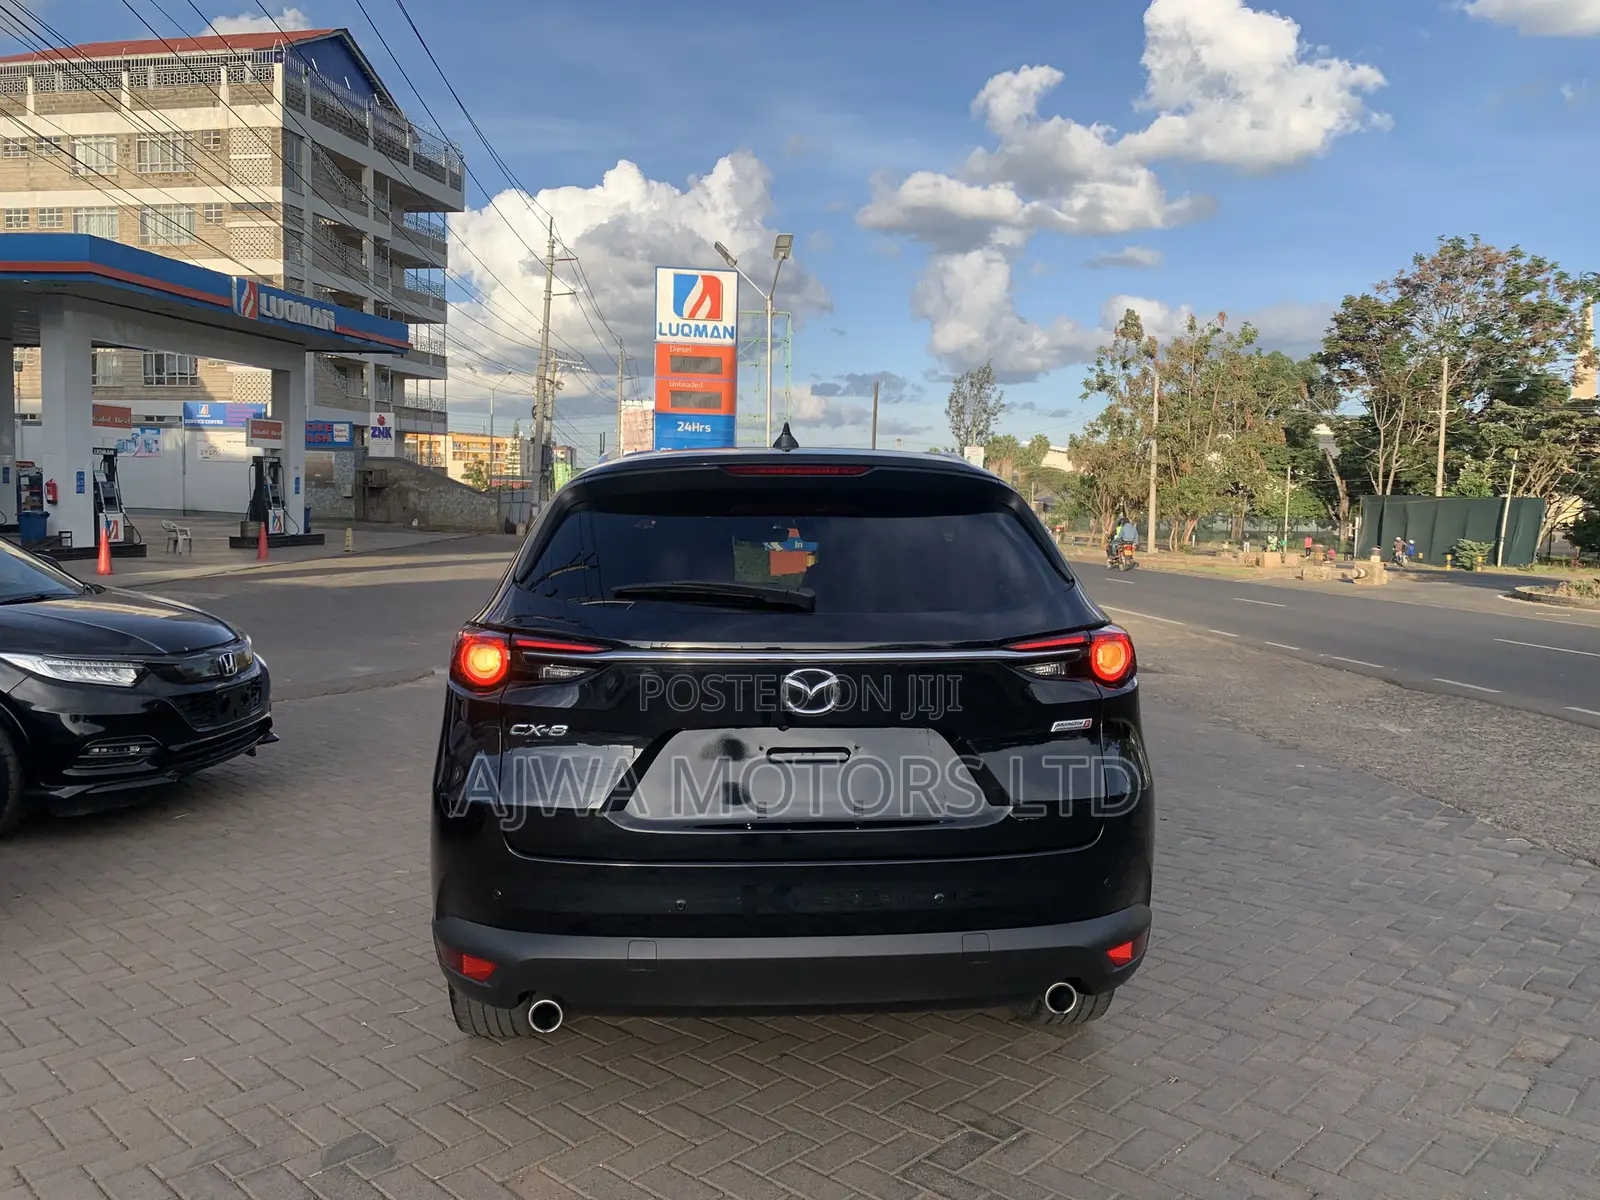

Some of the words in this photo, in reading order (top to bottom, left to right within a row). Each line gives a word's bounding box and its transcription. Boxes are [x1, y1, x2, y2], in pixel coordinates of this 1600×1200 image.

[259, 292, 336, 332] LUQMAN
[658, 322, 735, 339] LUQMAN
[669, 345, 692, 353] Diesel
[669, 381, 704, 389] Unleaded
[370, 427, 393, 439] ZNK
[676, 421, 712, 433] 24Hrs
[509, 724, 568, 737] CX-8
